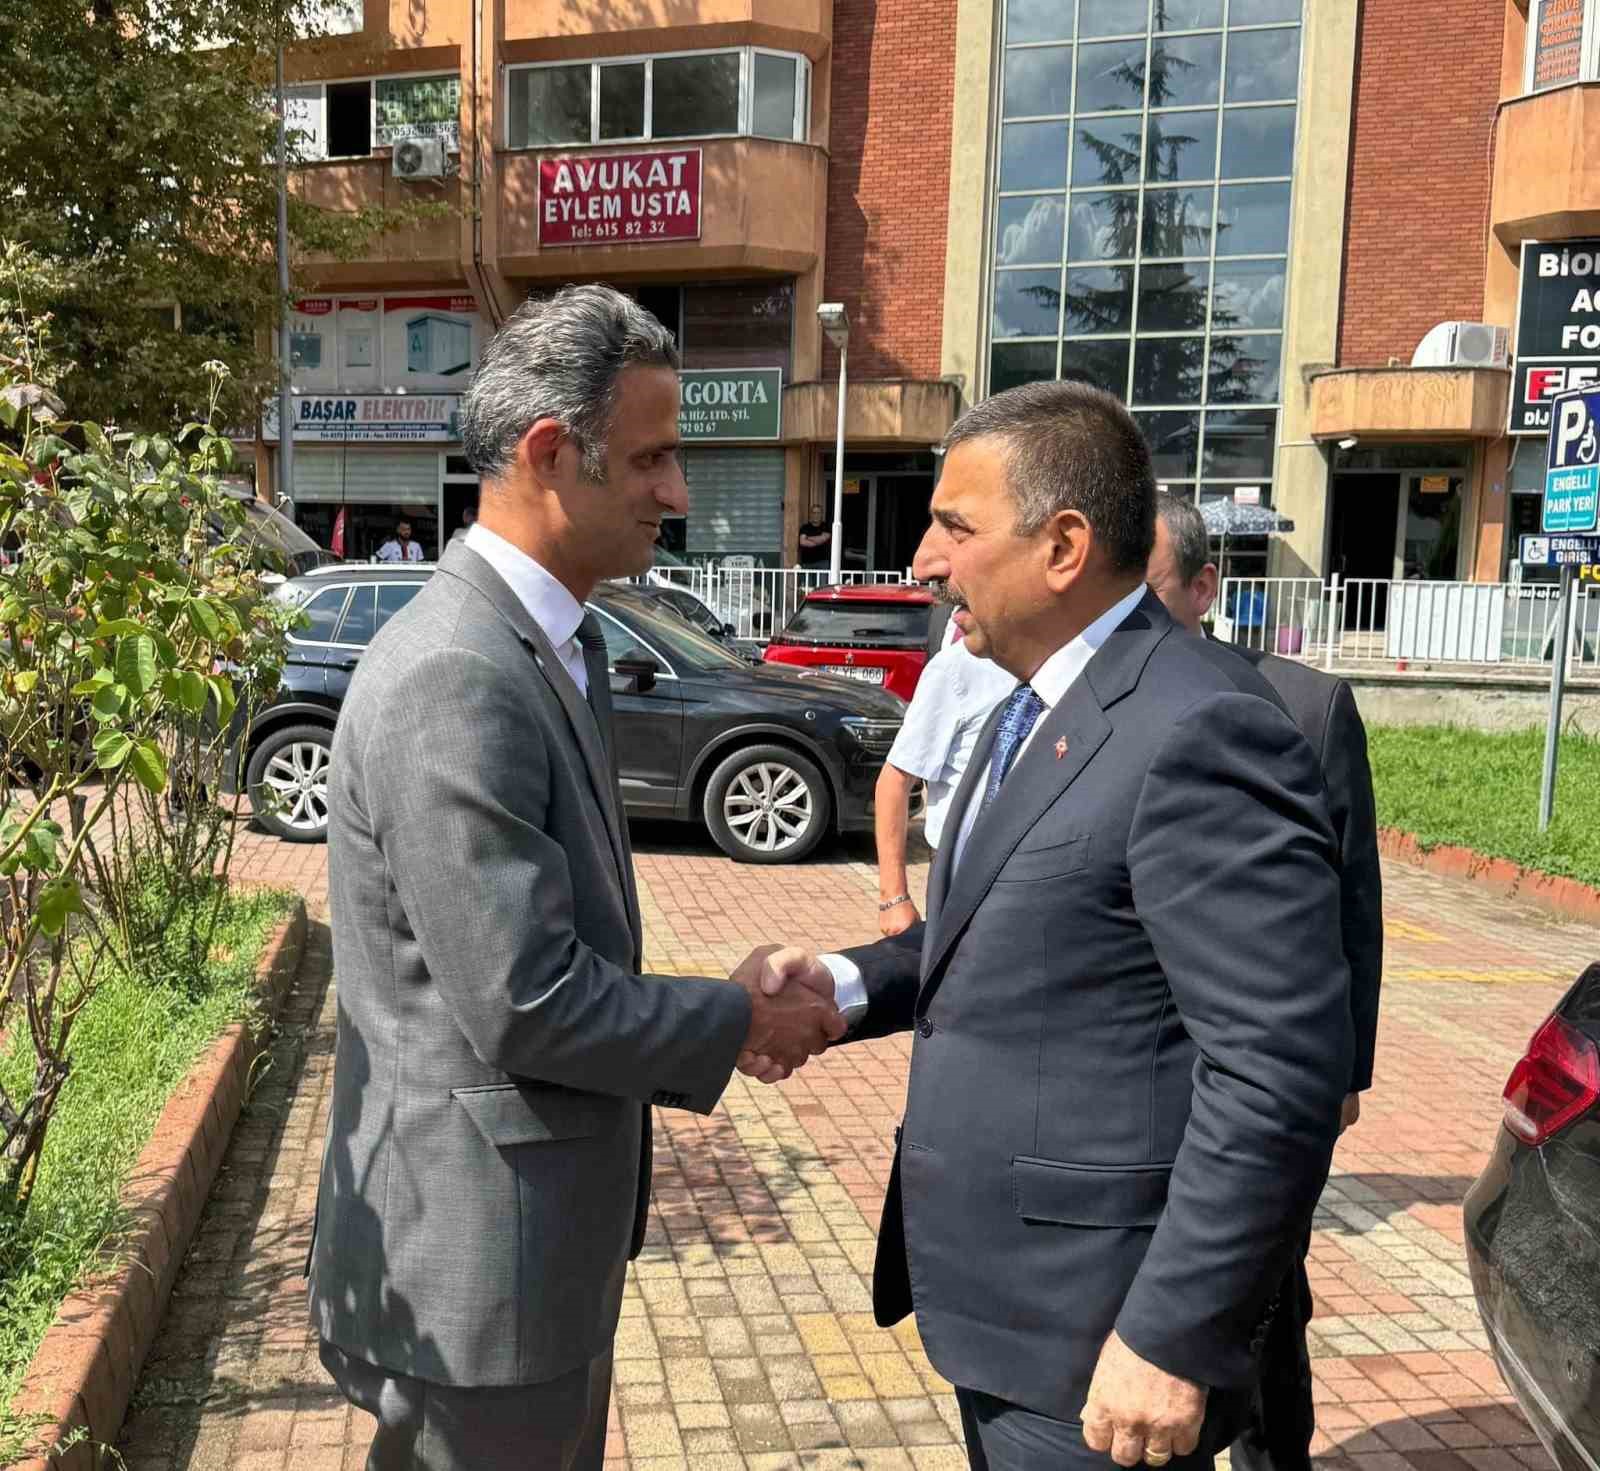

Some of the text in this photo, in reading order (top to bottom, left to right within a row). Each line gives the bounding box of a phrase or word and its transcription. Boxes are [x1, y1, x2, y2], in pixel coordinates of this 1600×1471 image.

[553, 155, 687, 194] AVUKAT
[544, 189, 692, 223] EYLEM USTA
[571, 220, 665, 239] Tel: 615 82 32
[300, 397, 447, 421] BAŞAR ELEKTRİK
[1555, 399, 1587, 467] P
[1552, 469, 1592, 492] ENGELLİ
[1547, 491, 1595, 514] PARK YERİ
